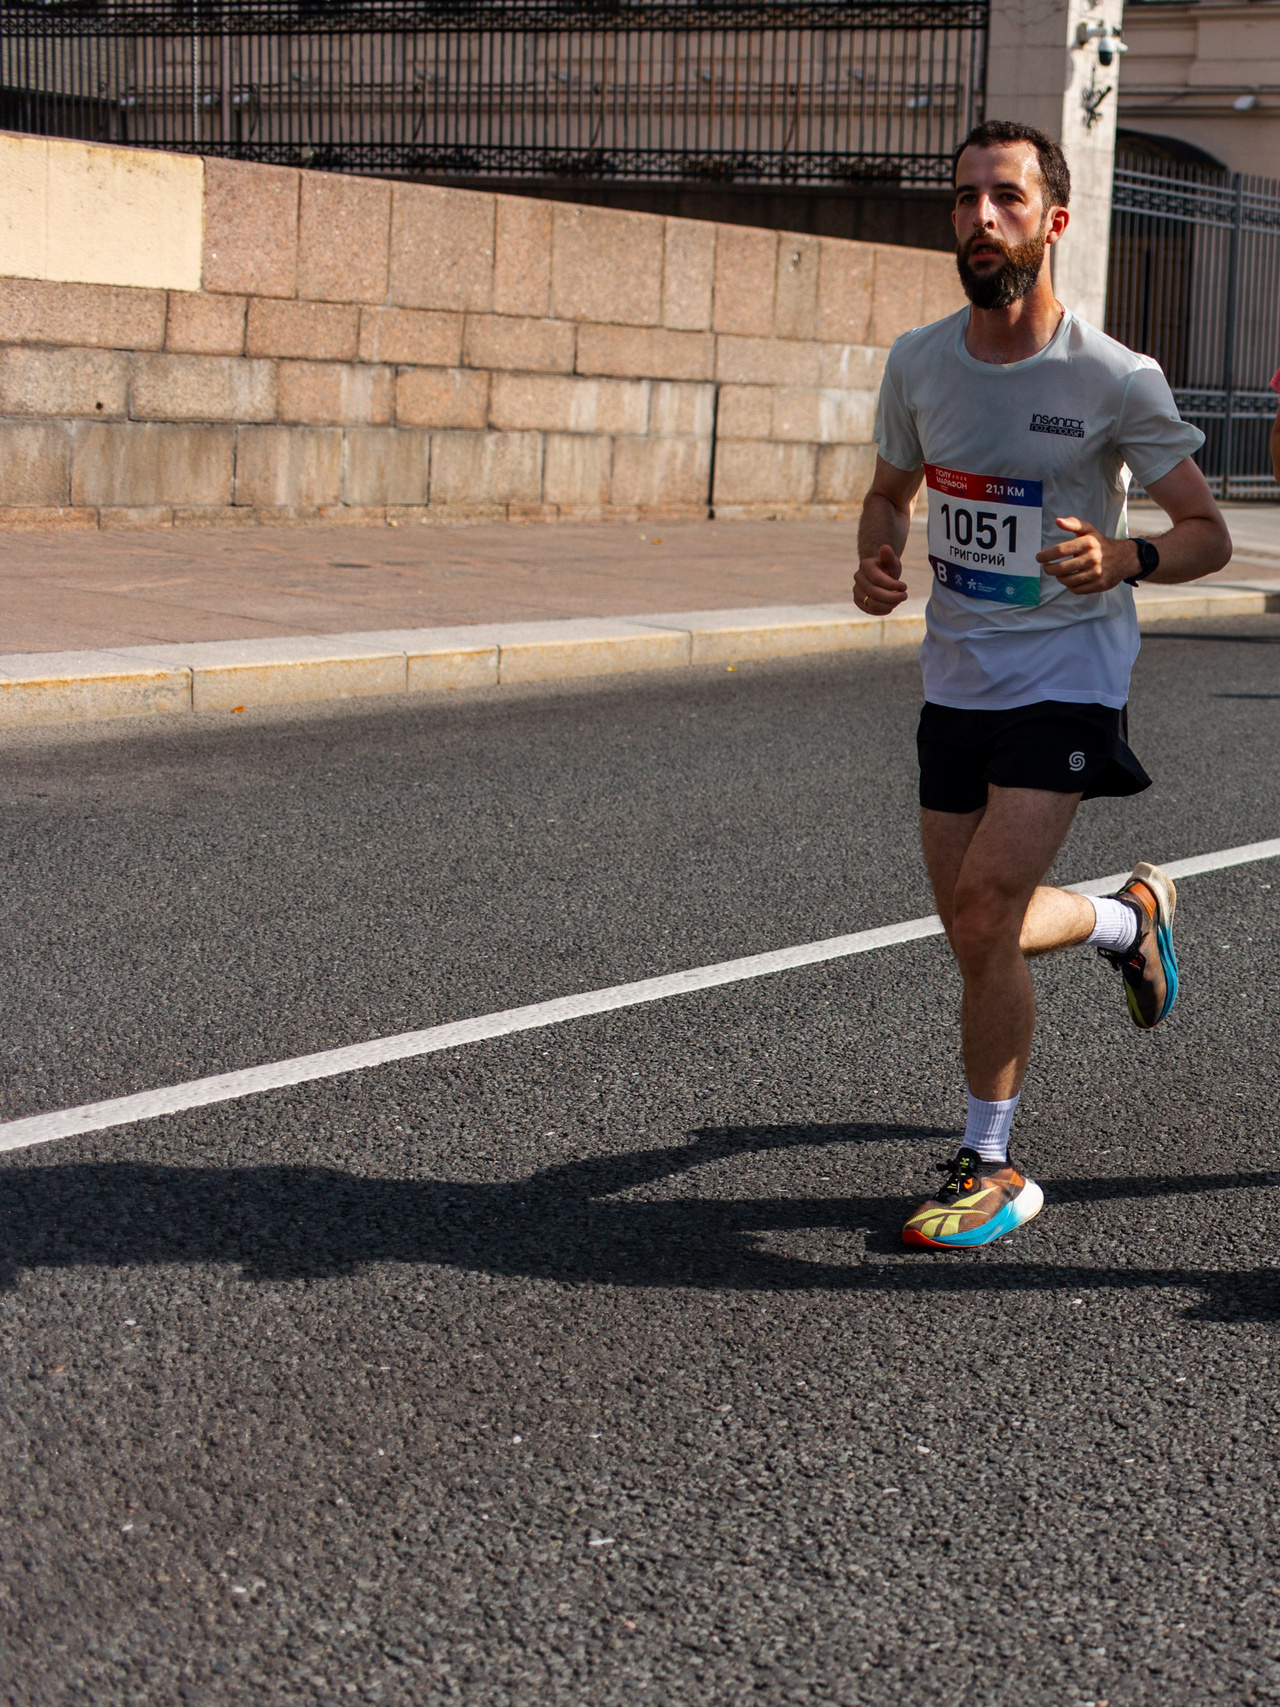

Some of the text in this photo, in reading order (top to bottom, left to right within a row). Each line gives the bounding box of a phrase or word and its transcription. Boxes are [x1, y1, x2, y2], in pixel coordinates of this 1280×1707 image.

[935, 468, 952, 479] ПОЛУ
[936, 475, 968, 490] МАРАФОН
[985, 483, 1025, 498] 21,1 КМ
[940, 503, 1018, 553] 1051
[949, 545, 1005, 566] ГРИГОРИЙ
[936, 561, 948, 582] B
